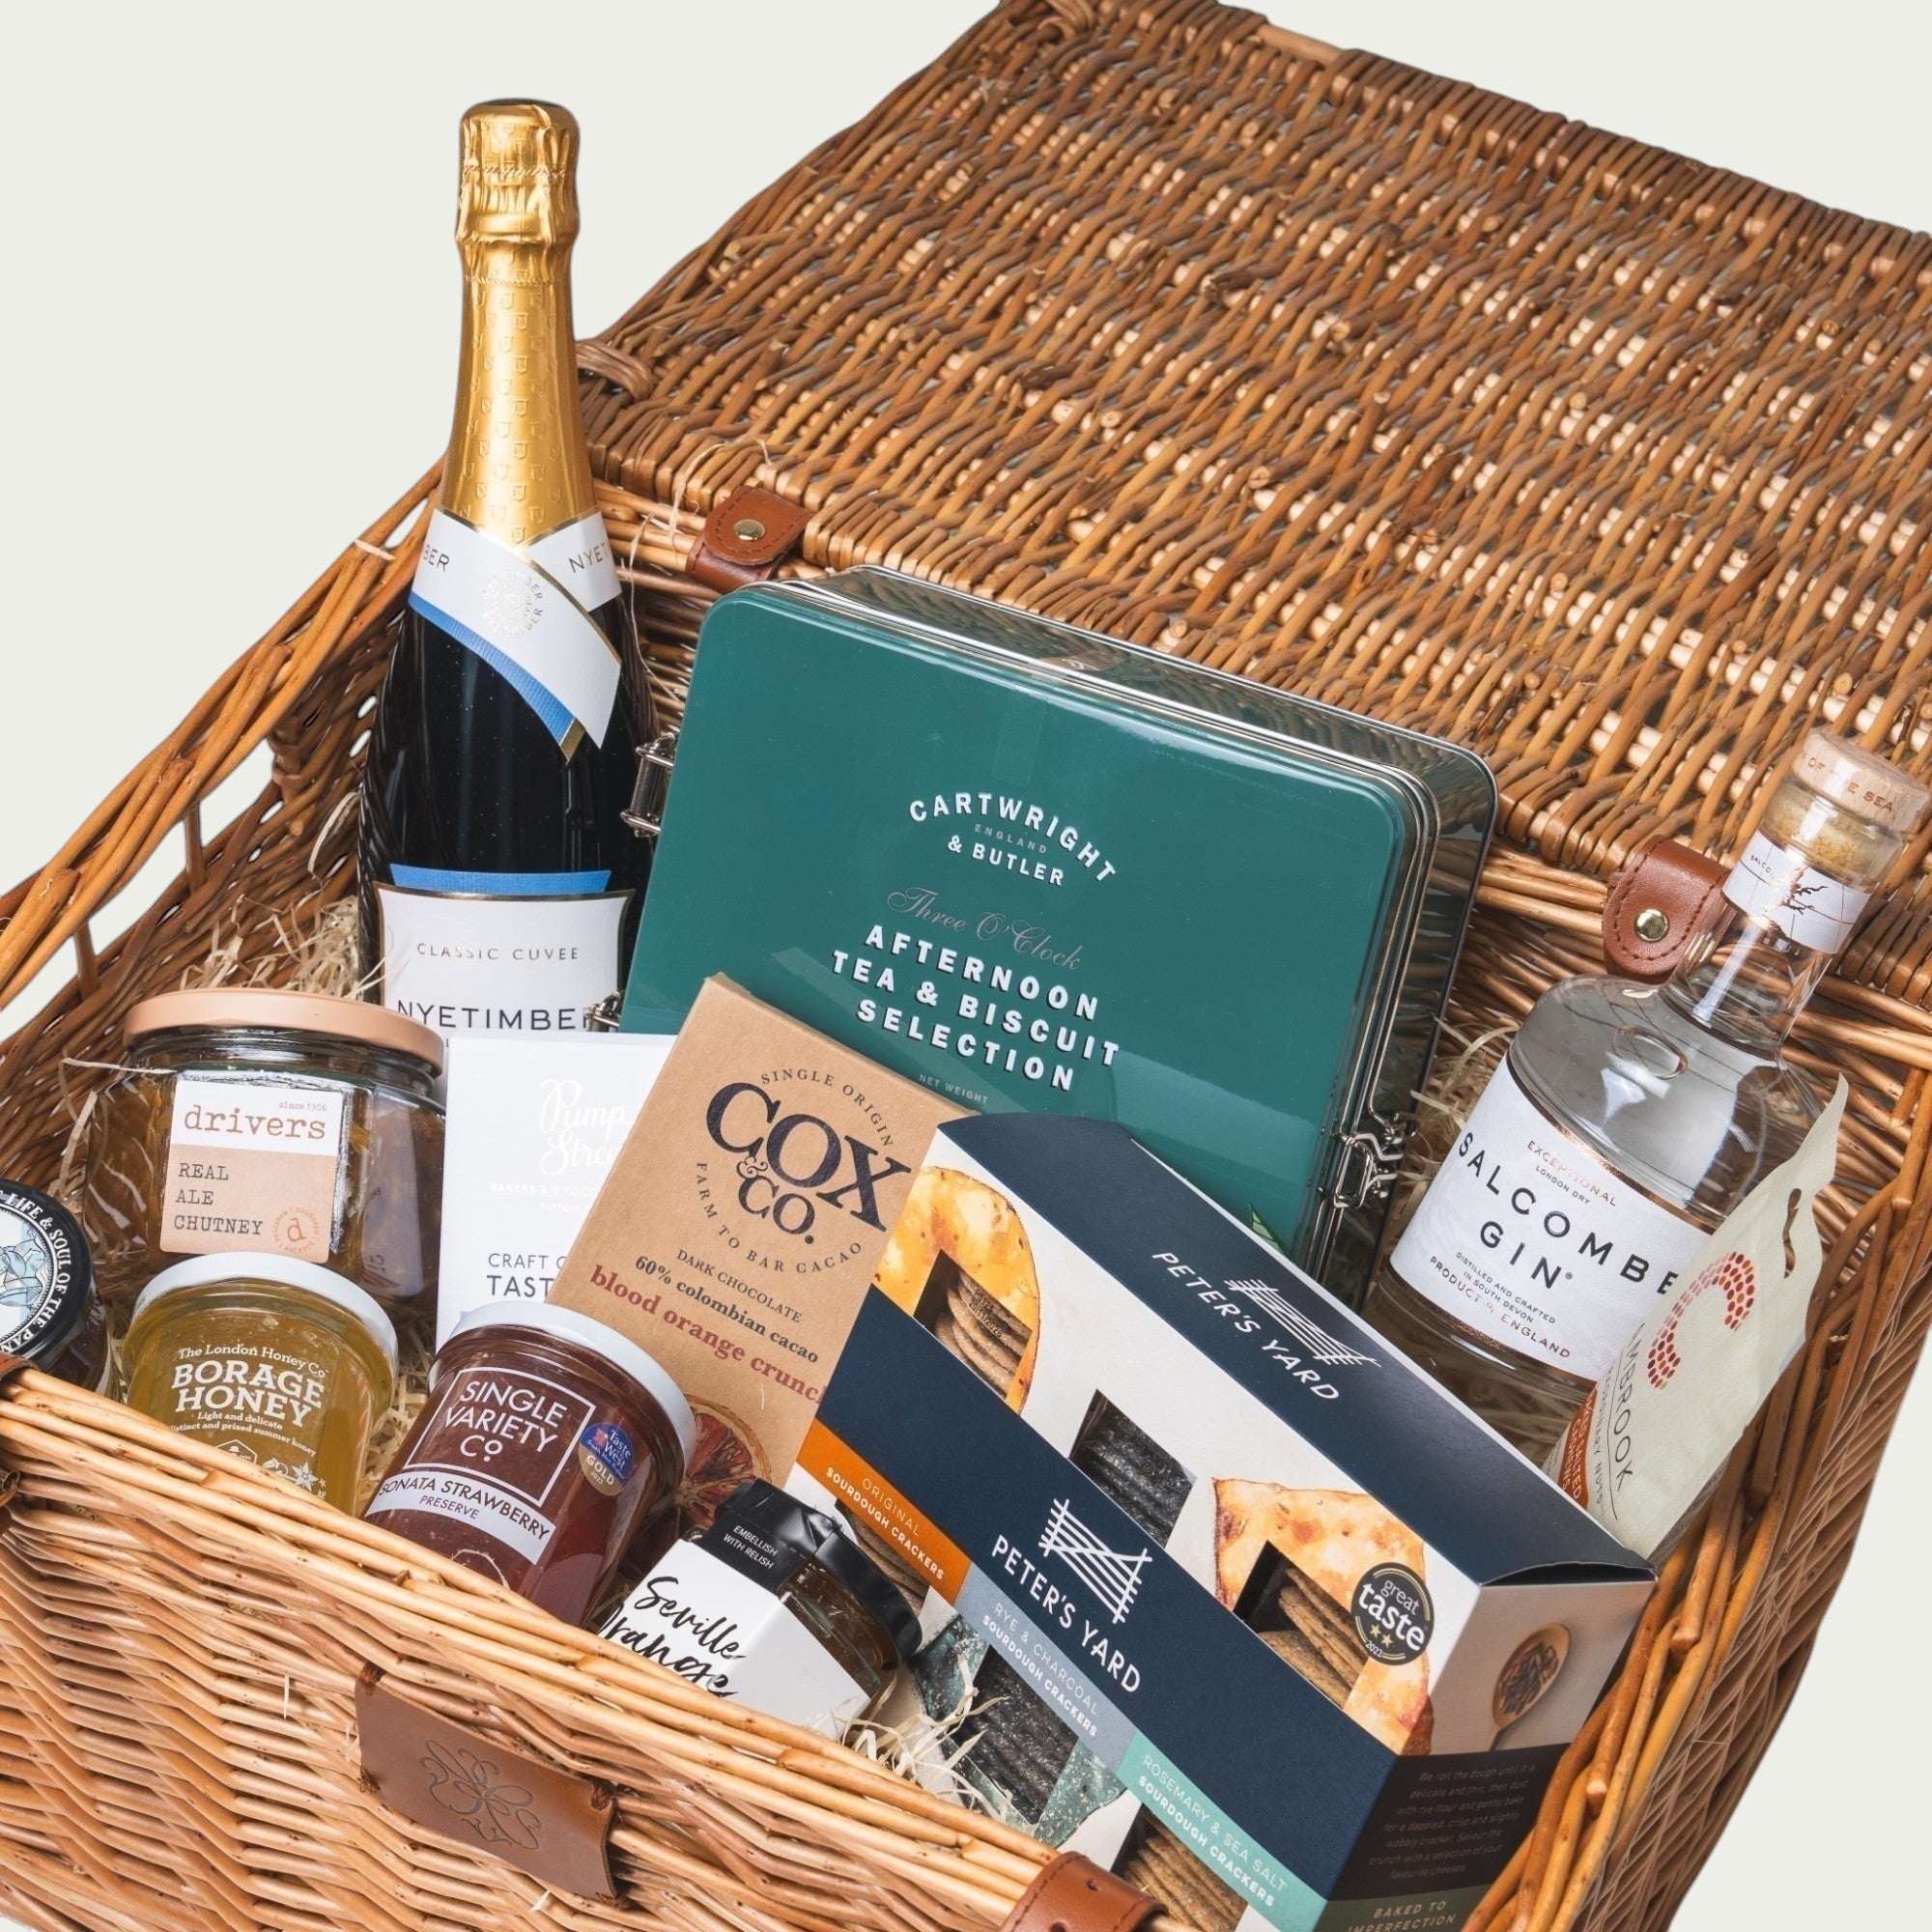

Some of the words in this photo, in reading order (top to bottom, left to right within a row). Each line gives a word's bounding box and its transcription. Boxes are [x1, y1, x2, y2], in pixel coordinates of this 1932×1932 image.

[1863, 790, 1893, 812] SEA
[909, 792, 1116, 881] CARTWRIGHT
[948, 834, 962, 854] &
[972, 842, 1064, 886] BUTLER
[975, 823, 1047, 854] ENGLAND
[417, 943, 498, 960] CLASSIC
[513, 947, 579, 960] CUVEE
[887, 887, 966, 932] Three
[977, 912, 1083, 970] O'Clock
[866, 924, 1098, 1020] AFTERNOON
[832, 950, 895, 992] TEA
[916, 981, 937, 1007] &
[958, 994, 1120, 1065] BISCUIT
[857, 999, 1074, 1092] SELECTION
[540, 1079, 633, 1140] Pump
[761, 1068, 835, 1087] SINGLE
[842, 1084, 893, 1148] ORIGIN
[919, 1074, 940, 1088] NET
[945, 1083, 988, 1104] WEIGHT
[185, 1105, 326, 1140] drivers
[178, 1162, 229, 1180] REAL
[706, 1082, 911, 1233] COX
[736, 1155, 769, 1179] &
[1526, 1140, 1617, 1207] EXCEPTIONAL
[4, 1192, 43, 1218] LIFE
[175, 1189, 214, 1205] ALE
[491, 1182, 535, 1193] BAKERS
[1535, 1165, 1570, 1192] LONDON
[1572, 1190, 1591, 1205] DRY
[39, 1217, 53, 1230] &
[174, 1214, 264, 1236] CHUTNEY
[696, 1161, 718, 1219] FARM
[718, 1224, 740, 1249] TO
[746, 1250, 783, 1272] BAR
[796, 1242, 862, 1274] CACAO
[1459, 1132, 1679, 1294] SALCOMBE
[49, 1229, 71, 1270] SOUL
[488, 1253, 549, 1269] CRAFT
[56, 1274, 71, 1294] OF
[677, 1248, 715, 1277] DARK
[717, 1271, 803, 1323] CHOCOLATE
[1429, 1256, 1483, 1303] PRODUCT
[1500, 1312, 1571, 1358] ENGLAND
[1456, 1252, 1492, 1284] DISTILLED
[1493, 1283, 1513, 1297] AND
[1515, 1296, 1556, 1323] CRAFTED
[1463, 1270, 1472, 1281] IN
[1473, 1278, 1501, 1303] SOUTH
[1503, 1300, 1534, 1323] DEVON
[32, 1298, 63, 1328] THE
[589, 1264, 662, 1316] blood
[663, 1308, 746, 1360] orange
[635, 1256, 671, 1285] 60%
[676, 1279, 767, 1337] colombian
[770, 1331, 818, 1363] cacao
[1151, 1252, 1261, 1333] PETER'S
[1262, 1339, 1340, 1399] YARD
[178, 1347, 203, 1360] The
[205, 1344, 258, 1356] London
[262, 1347, 306, 1371] Honey
[171, 1359, 325, 1409] BORAGE
[175, 1385, 312, 1428] HONEY
[461, 1380, 567, 1428] SINGLE
[171, 1423, 200, 1432] istinct
[202, 1421, 220, 1430] and
[221, 1423, 252, 1434] prized
[254, 1428, 291, 1444] summer
[292, 1436, 317, 1458] honey
[197, 1411, 222, 1421] Light
[224, 1412, 243, 1422] and
[245, 1413, 283, 1431] delicate
[444, 1406, 558, 1453] VARIETY
[610, 1430, 632, 1460] Taste
[586, 1454, 614, 1485] GOLD
[589, 1470, 604, 1485] 2023
[604, 1442, 626, 1469] West
[1572, 1439, 1585, 1499] SALTED
[379, 1477, 436, 1495] SONATA
[440, 1480, 550, 1541] STRAWBERRY
[419, 1495, 480, 1520] PRESERVE
[826, 1467, 889, 1528] SOURDOUGH
[892, 1526, 944, 1579] CRACKERS
[863, 1478, 921, 1537] ORIGINAL
[724, 1534, 746, 1551] WITH
[745, 1546, 774, 1570] RELISH
[733, 1525, 778, 1556] EMBELLISH
[634, 1577, 747, 1660] Seville
[991, 1534, 1076, 1629] PETER'S
[1081, 1619, 1141, 1692] YARD
[1358, 1583, 1425, 1651] taste
[1380, 1580, 1420, 1615] great
[597, 1605, 738, 1697] range
[994, 1603, 1018, 1630] RYE
[1021, 1631, 1030, 1643] &
[1033, 1644, 1097, 1716] CHARCOAL
[1365, 1639, 1383, 1658] 2022
[982, 1615, 1043, 1681] SOURDOUGH
[1044, 1680, 1097, 1737] CRACKERS
[1139, 1775, 1208, 1847] SOURDOUGH
[1209, 1846, 1275, 1907] CRACKERS
[1143, 1754, 1210, 1823] ROSEMARY
[1210, 1822, 1220, 1835] &
[1223, 1833, 1248, 1862] SEA
[1252, 1859, 1287, 1892] SALT
[1374, 1903, 1423, 1918] BAKED
[1430, 1901, 1447, 1912] TO
